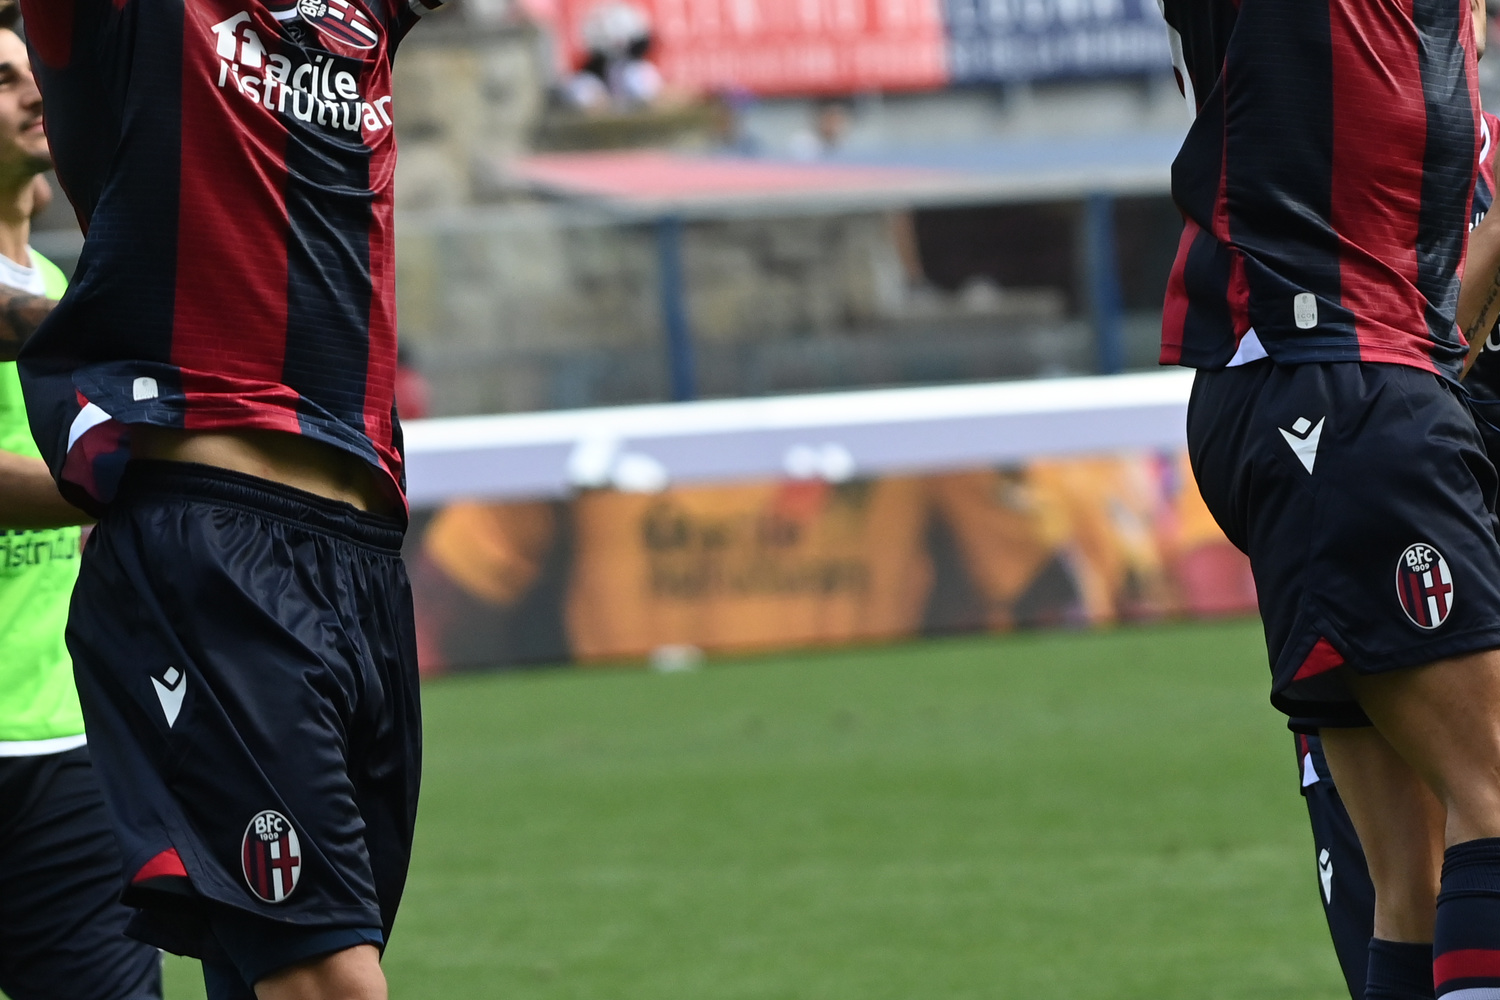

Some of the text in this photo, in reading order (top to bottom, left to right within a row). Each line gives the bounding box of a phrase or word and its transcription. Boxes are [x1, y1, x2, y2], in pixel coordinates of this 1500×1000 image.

[1405, 546, 1433, 567] BFC
[1412, 563, 1430, 572] 1909
[255, 813, 283, 834] BFC
[260, 832, 279, 841] 1909
